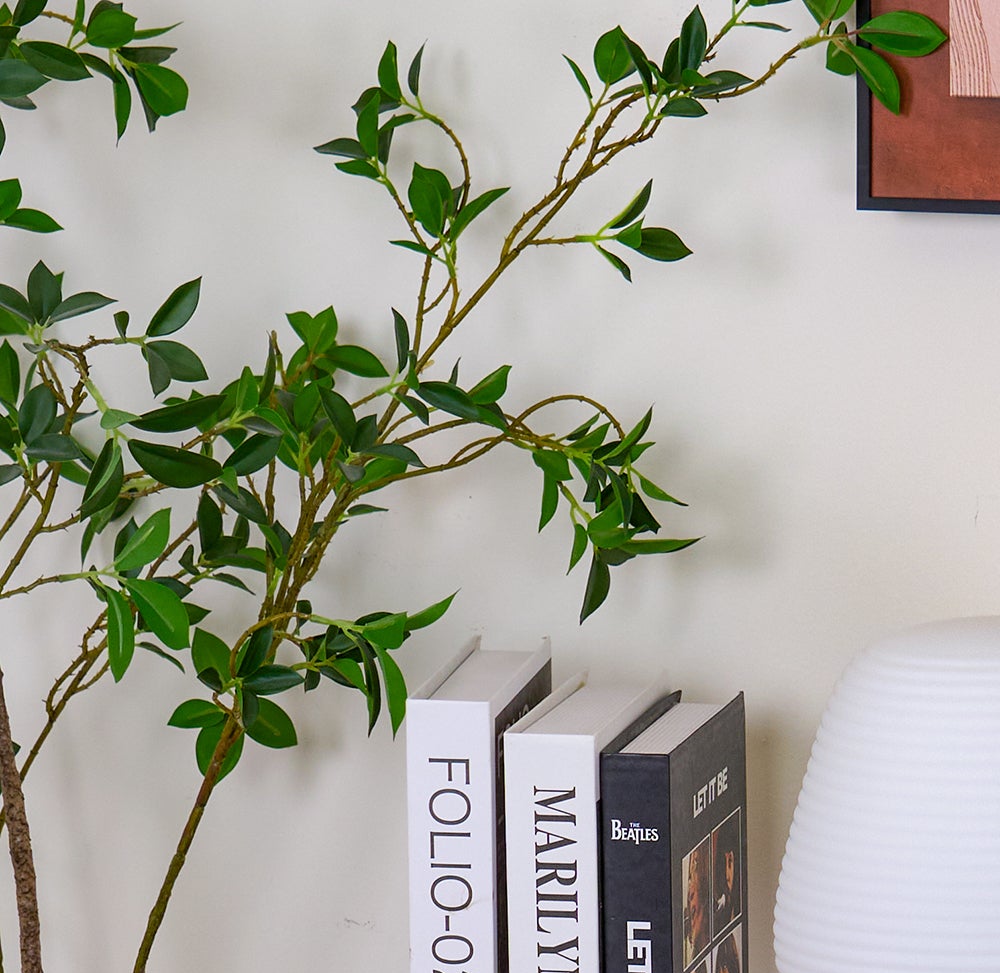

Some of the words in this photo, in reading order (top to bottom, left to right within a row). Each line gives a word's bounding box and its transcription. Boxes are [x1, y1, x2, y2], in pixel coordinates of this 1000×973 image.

[693, 784, 708, 818] LET
[708, 776, 717, 804] IT
[717, 766, 728, 797] BE
[611, 819, 659, 845] BEATLES
